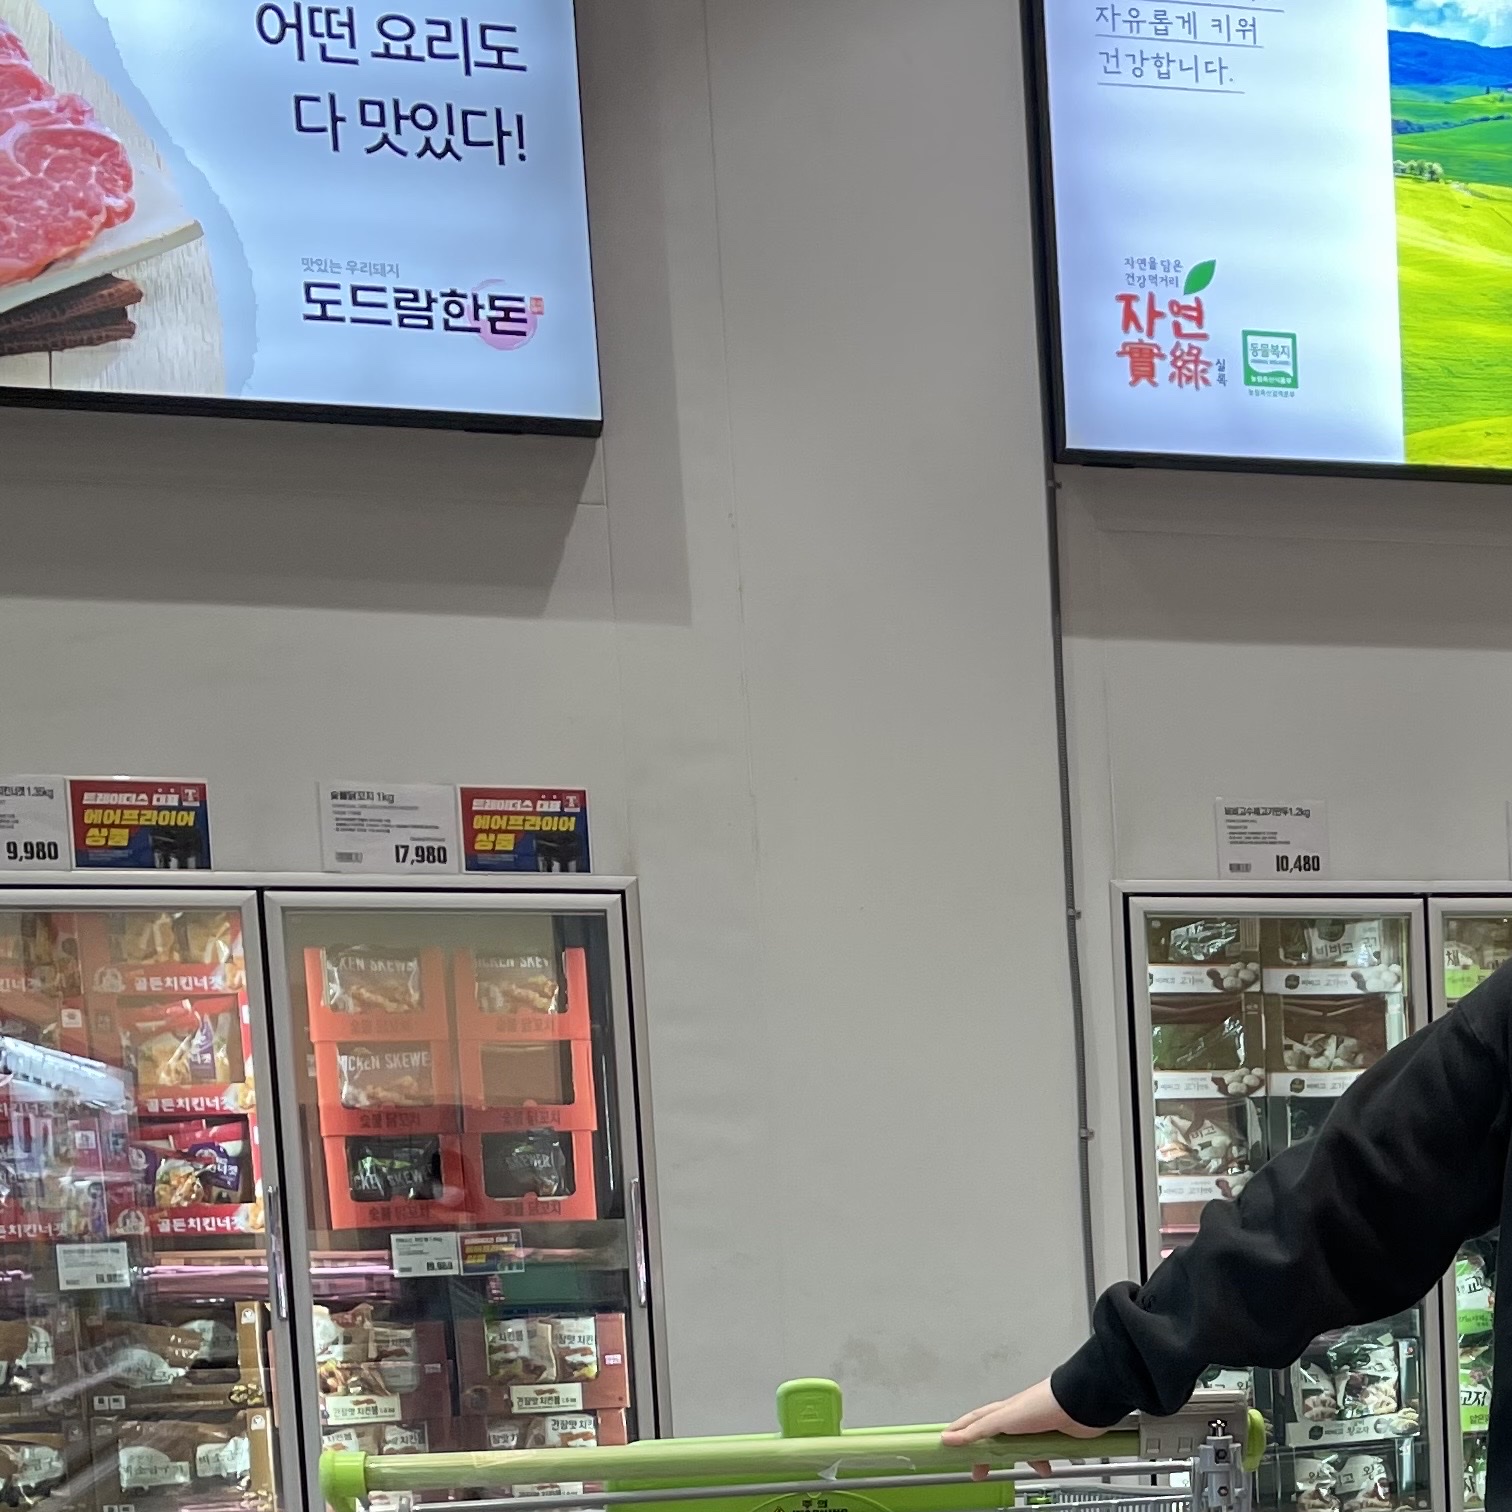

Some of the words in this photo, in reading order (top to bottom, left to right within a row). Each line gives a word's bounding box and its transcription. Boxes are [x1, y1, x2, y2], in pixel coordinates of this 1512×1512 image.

[1095, 4, 1198, 40] 자유롭게
[1210, 14, 1257, 45] 키워
[255, 1, 360, 66] 어떤
[370, 13, 528, 77] 요리도
[1099, 48, 1234, 86] 건강합니다.
[293, 92, 347, 153] 다
[358, 98, 527, 166] 맛있다!
[301, 257, 342, 275] 맛있는
[345, 260, 400, 279] 우리돼지
[1124, 257, 1159, 270] 자연을
[302, 280, 529, 337] 도드람한돈
[1115, 291, 1210, 341] 자연
[1249, 343, 1291, 359] 동물복지
[377, 792, 394, 804] 1kg
[84, 809, 196, 826] 에어프라이어
[472, 814, 577, 831] 에어프라이어
[85, 827, 130, 846] 상품
[474, 832, 516, 851] 상품
[6, 841, 59, 862] 9,980
[394, 844, 448, 866] 17,980
[1275, 854, 1321, 873] 10,480
[1315, 942, 1354, 957] 비비고
